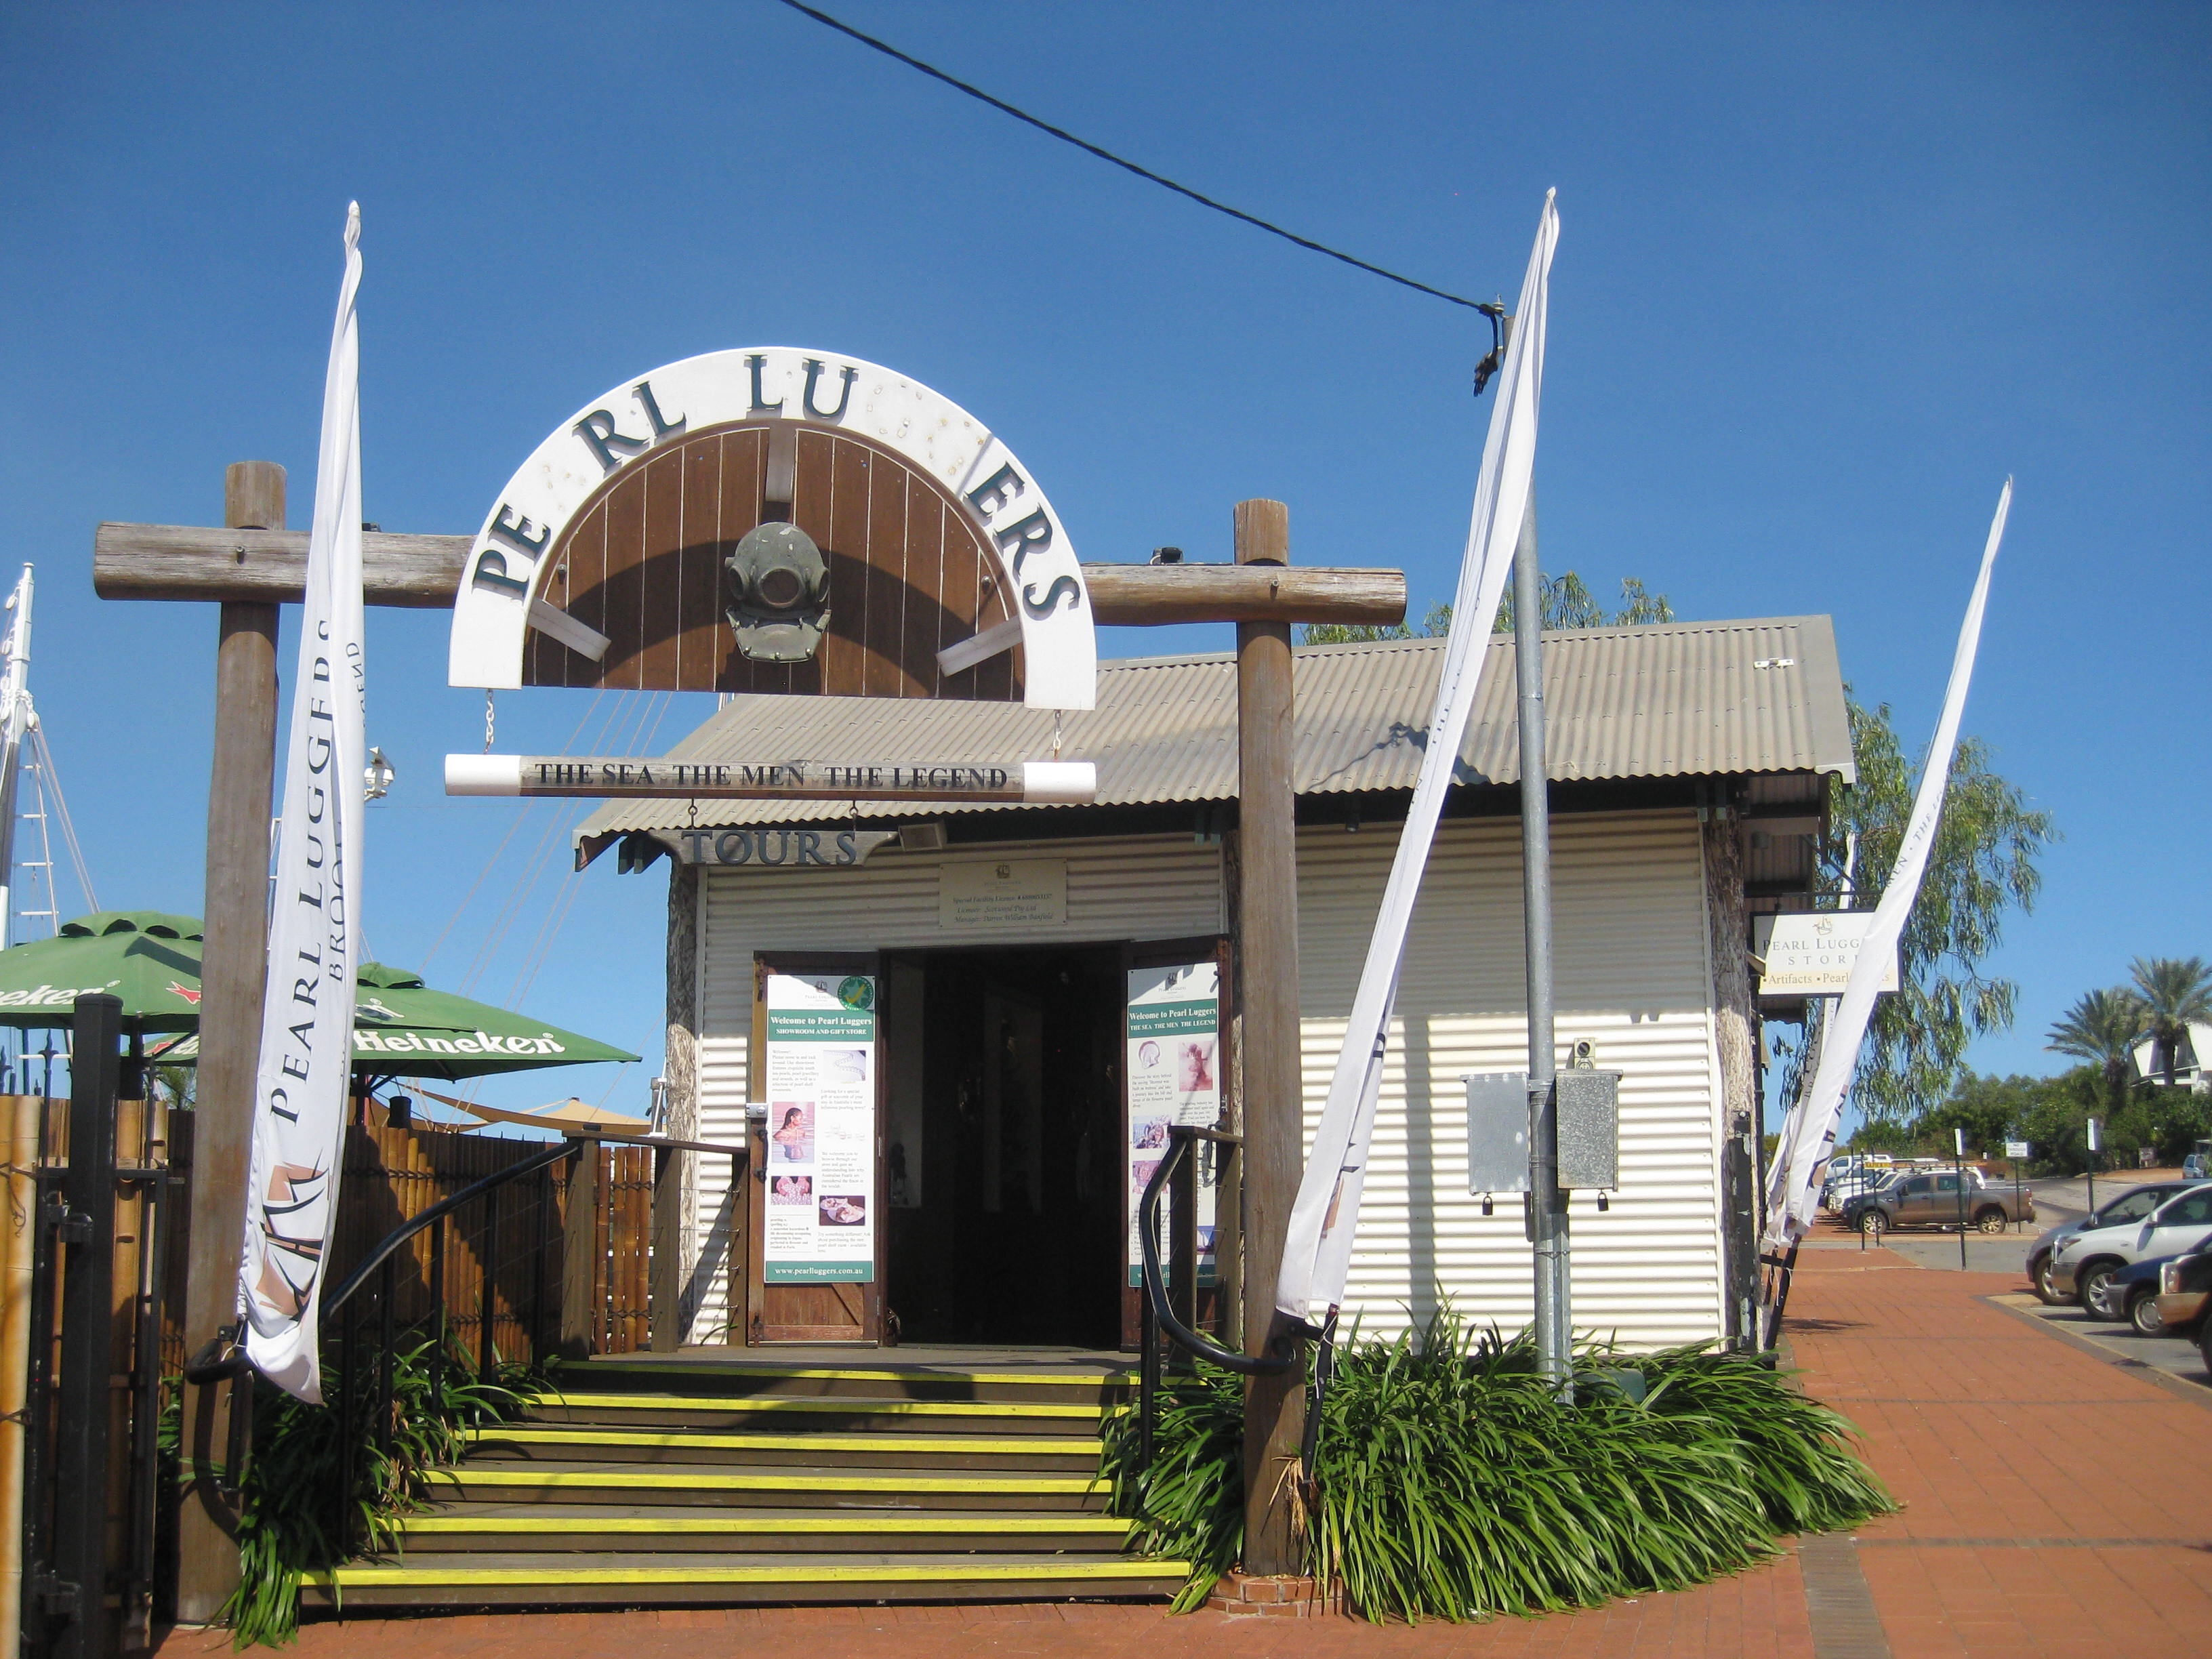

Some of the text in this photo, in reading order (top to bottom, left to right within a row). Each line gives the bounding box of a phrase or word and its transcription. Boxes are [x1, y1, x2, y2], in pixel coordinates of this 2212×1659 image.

[534, 763, 1008, 788] THE SEA THE MEN THE LEGEND
[680, 830, 857, 866] TOURS
[1763, 938, 1860, 951] PEARL LUGG
[1769, 973, 1812, 985] Artifacts
[1129, 1011, 1160, 1021] Welcome
[1169, 1008, 1187, 1018] Pearl
[1189, 1008, 1216, 1017] Luggers
[770, 1017, 806, 1025] Welcome
[817, 1017, 838, 1025] Pearl
[840, 1017, 872, 1027] Luggers
[270, 942, 322, 1127] PEARL
[352, 1029, 566, 1054] Heineken
[775, 1267, 863, 1275] www.pearlluggers.com.au
